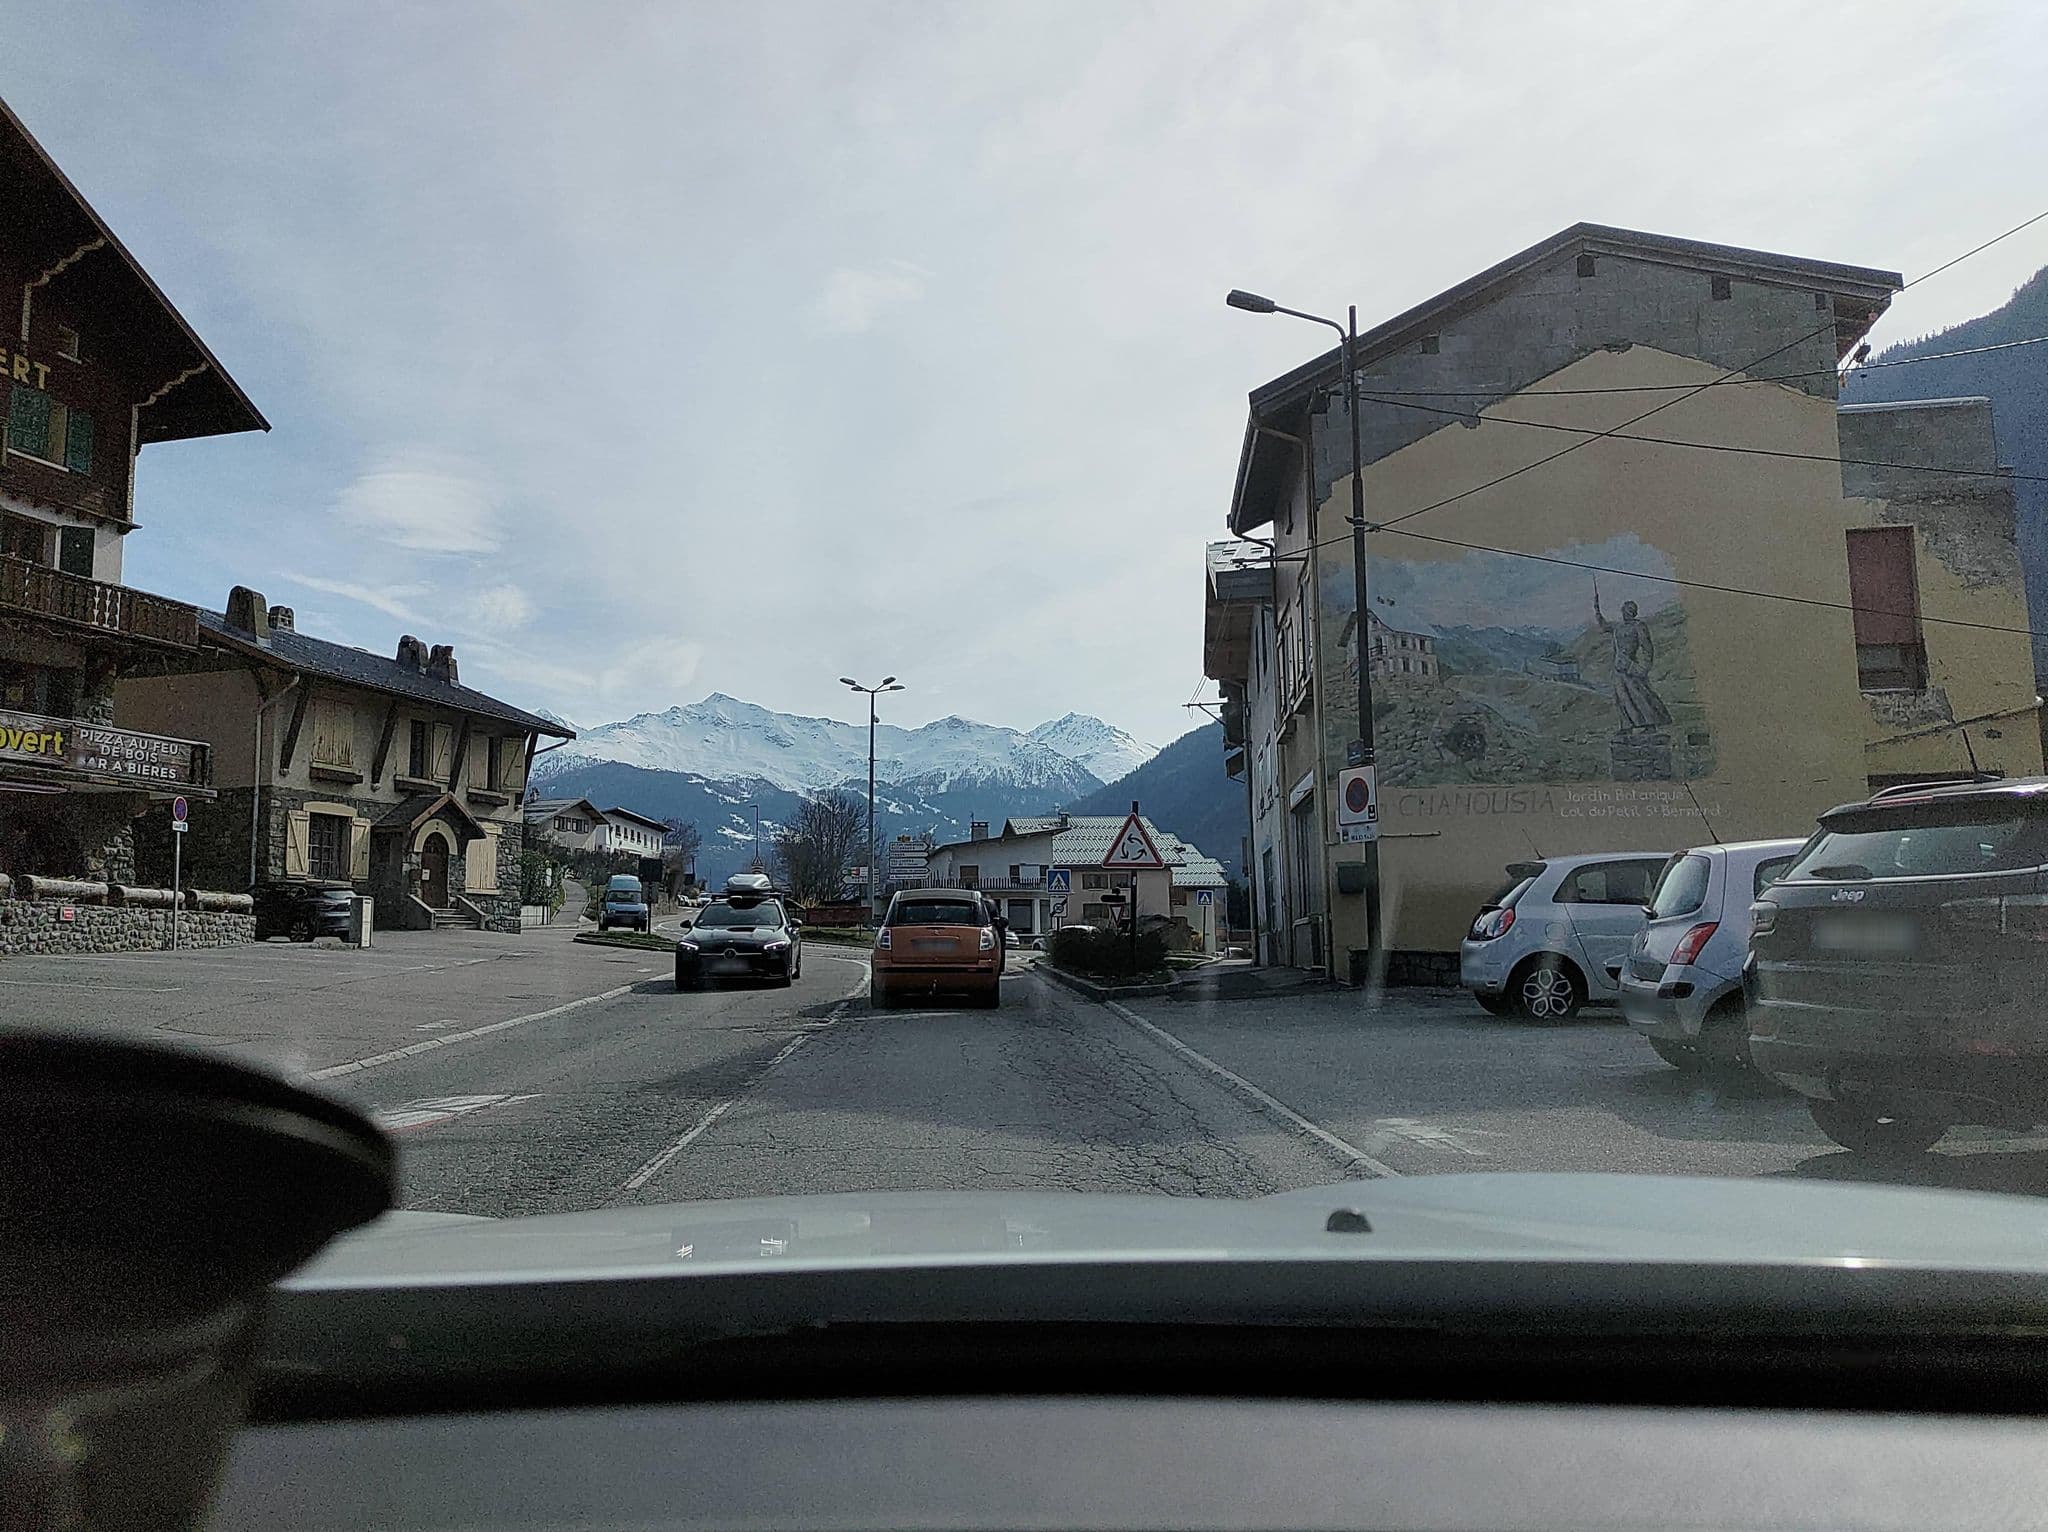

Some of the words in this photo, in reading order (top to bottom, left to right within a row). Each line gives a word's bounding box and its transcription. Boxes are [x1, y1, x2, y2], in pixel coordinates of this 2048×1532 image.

[80, 728, 124, 746] PIZZA
[129, 738, 148, 750] AU
[153, 741, 179, 755] FEU
[101, 745, 121, 758] DE
[126, 748, 158, 763] BOIS
[112, 761, 123, 772] A
[128, 762, 177, 779] BIERES
[1831, 888, 1865, 903] Jeep
